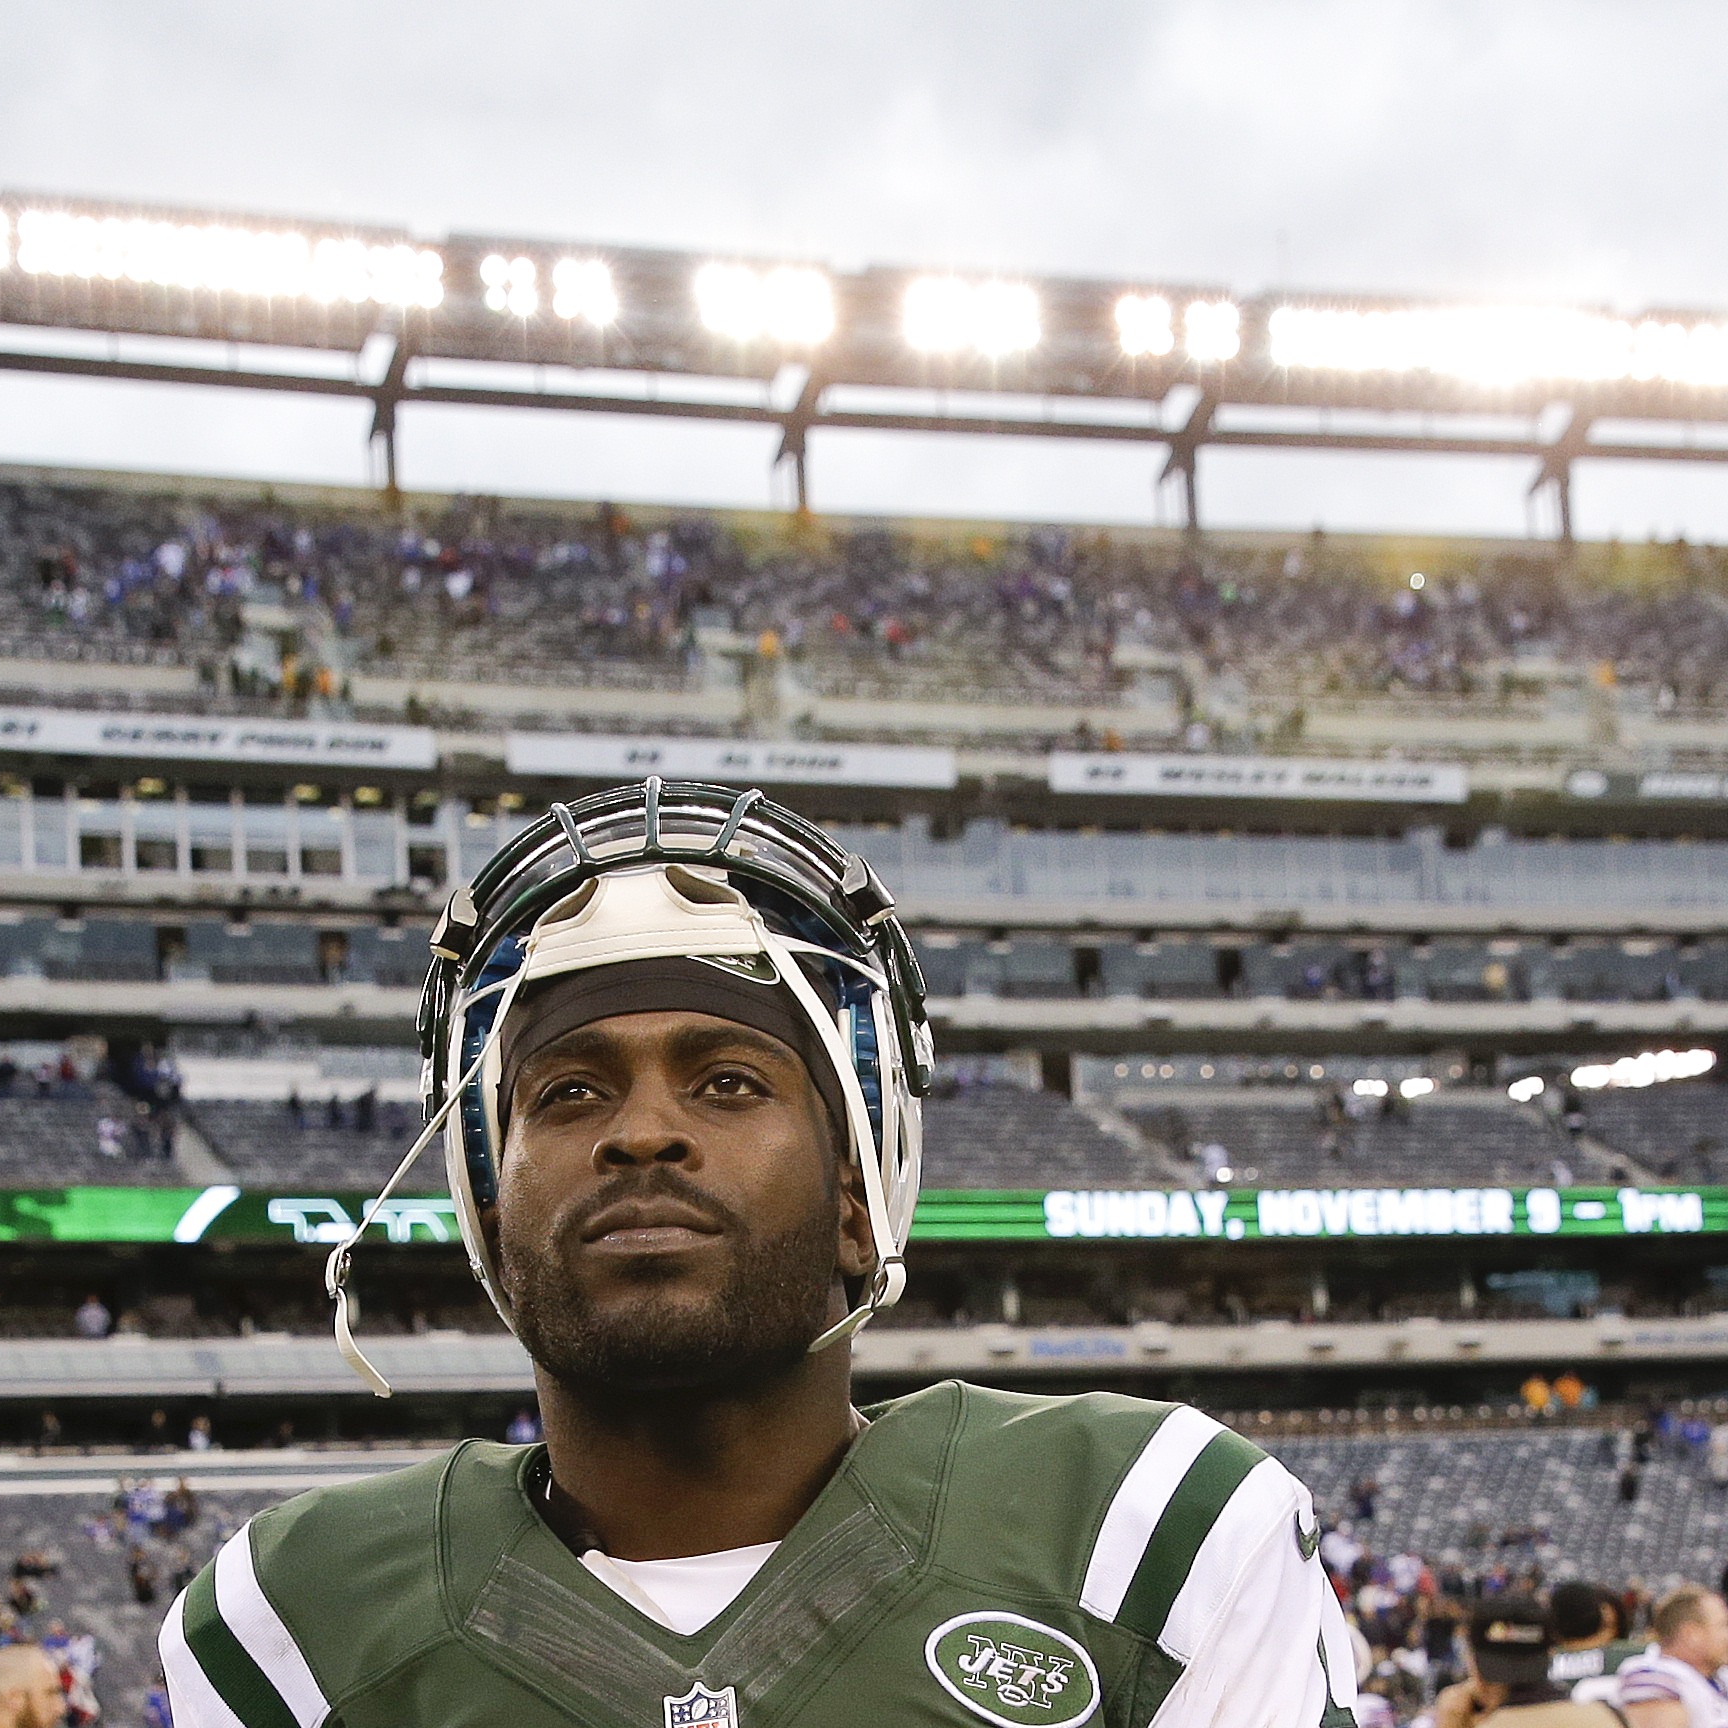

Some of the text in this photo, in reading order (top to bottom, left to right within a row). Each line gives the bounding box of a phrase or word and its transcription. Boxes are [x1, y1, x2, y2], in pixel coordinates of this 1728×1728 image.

[1042, 1189, 1246, 1241] SUNDAY,
[1256, 1187, 1515, 1237] NOVEMBER
[957, 1646, 1070, 1695] JETS
